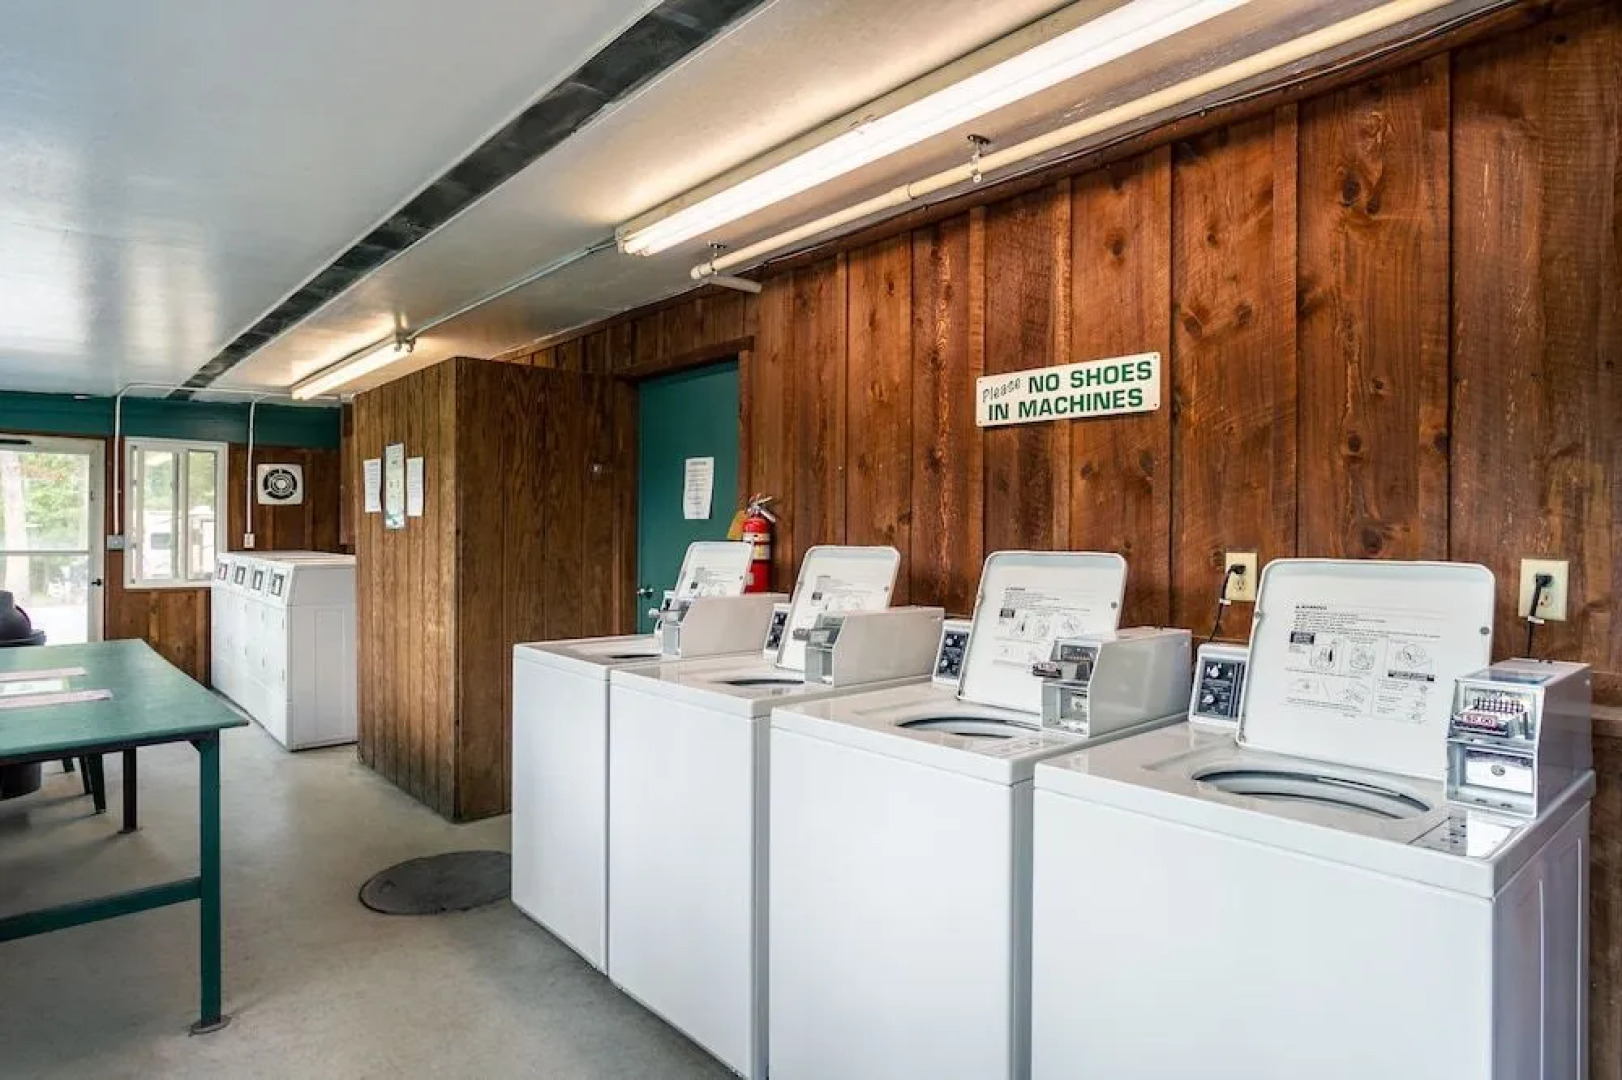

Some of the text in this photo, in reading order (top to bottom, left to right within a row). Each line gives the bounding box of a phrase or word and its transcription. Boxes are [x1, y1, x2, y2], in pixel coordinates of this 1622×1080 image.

[982, 360, 1152, 402] Please NO SHOES
[988, 388, 1143, 421] IN MACHINES
